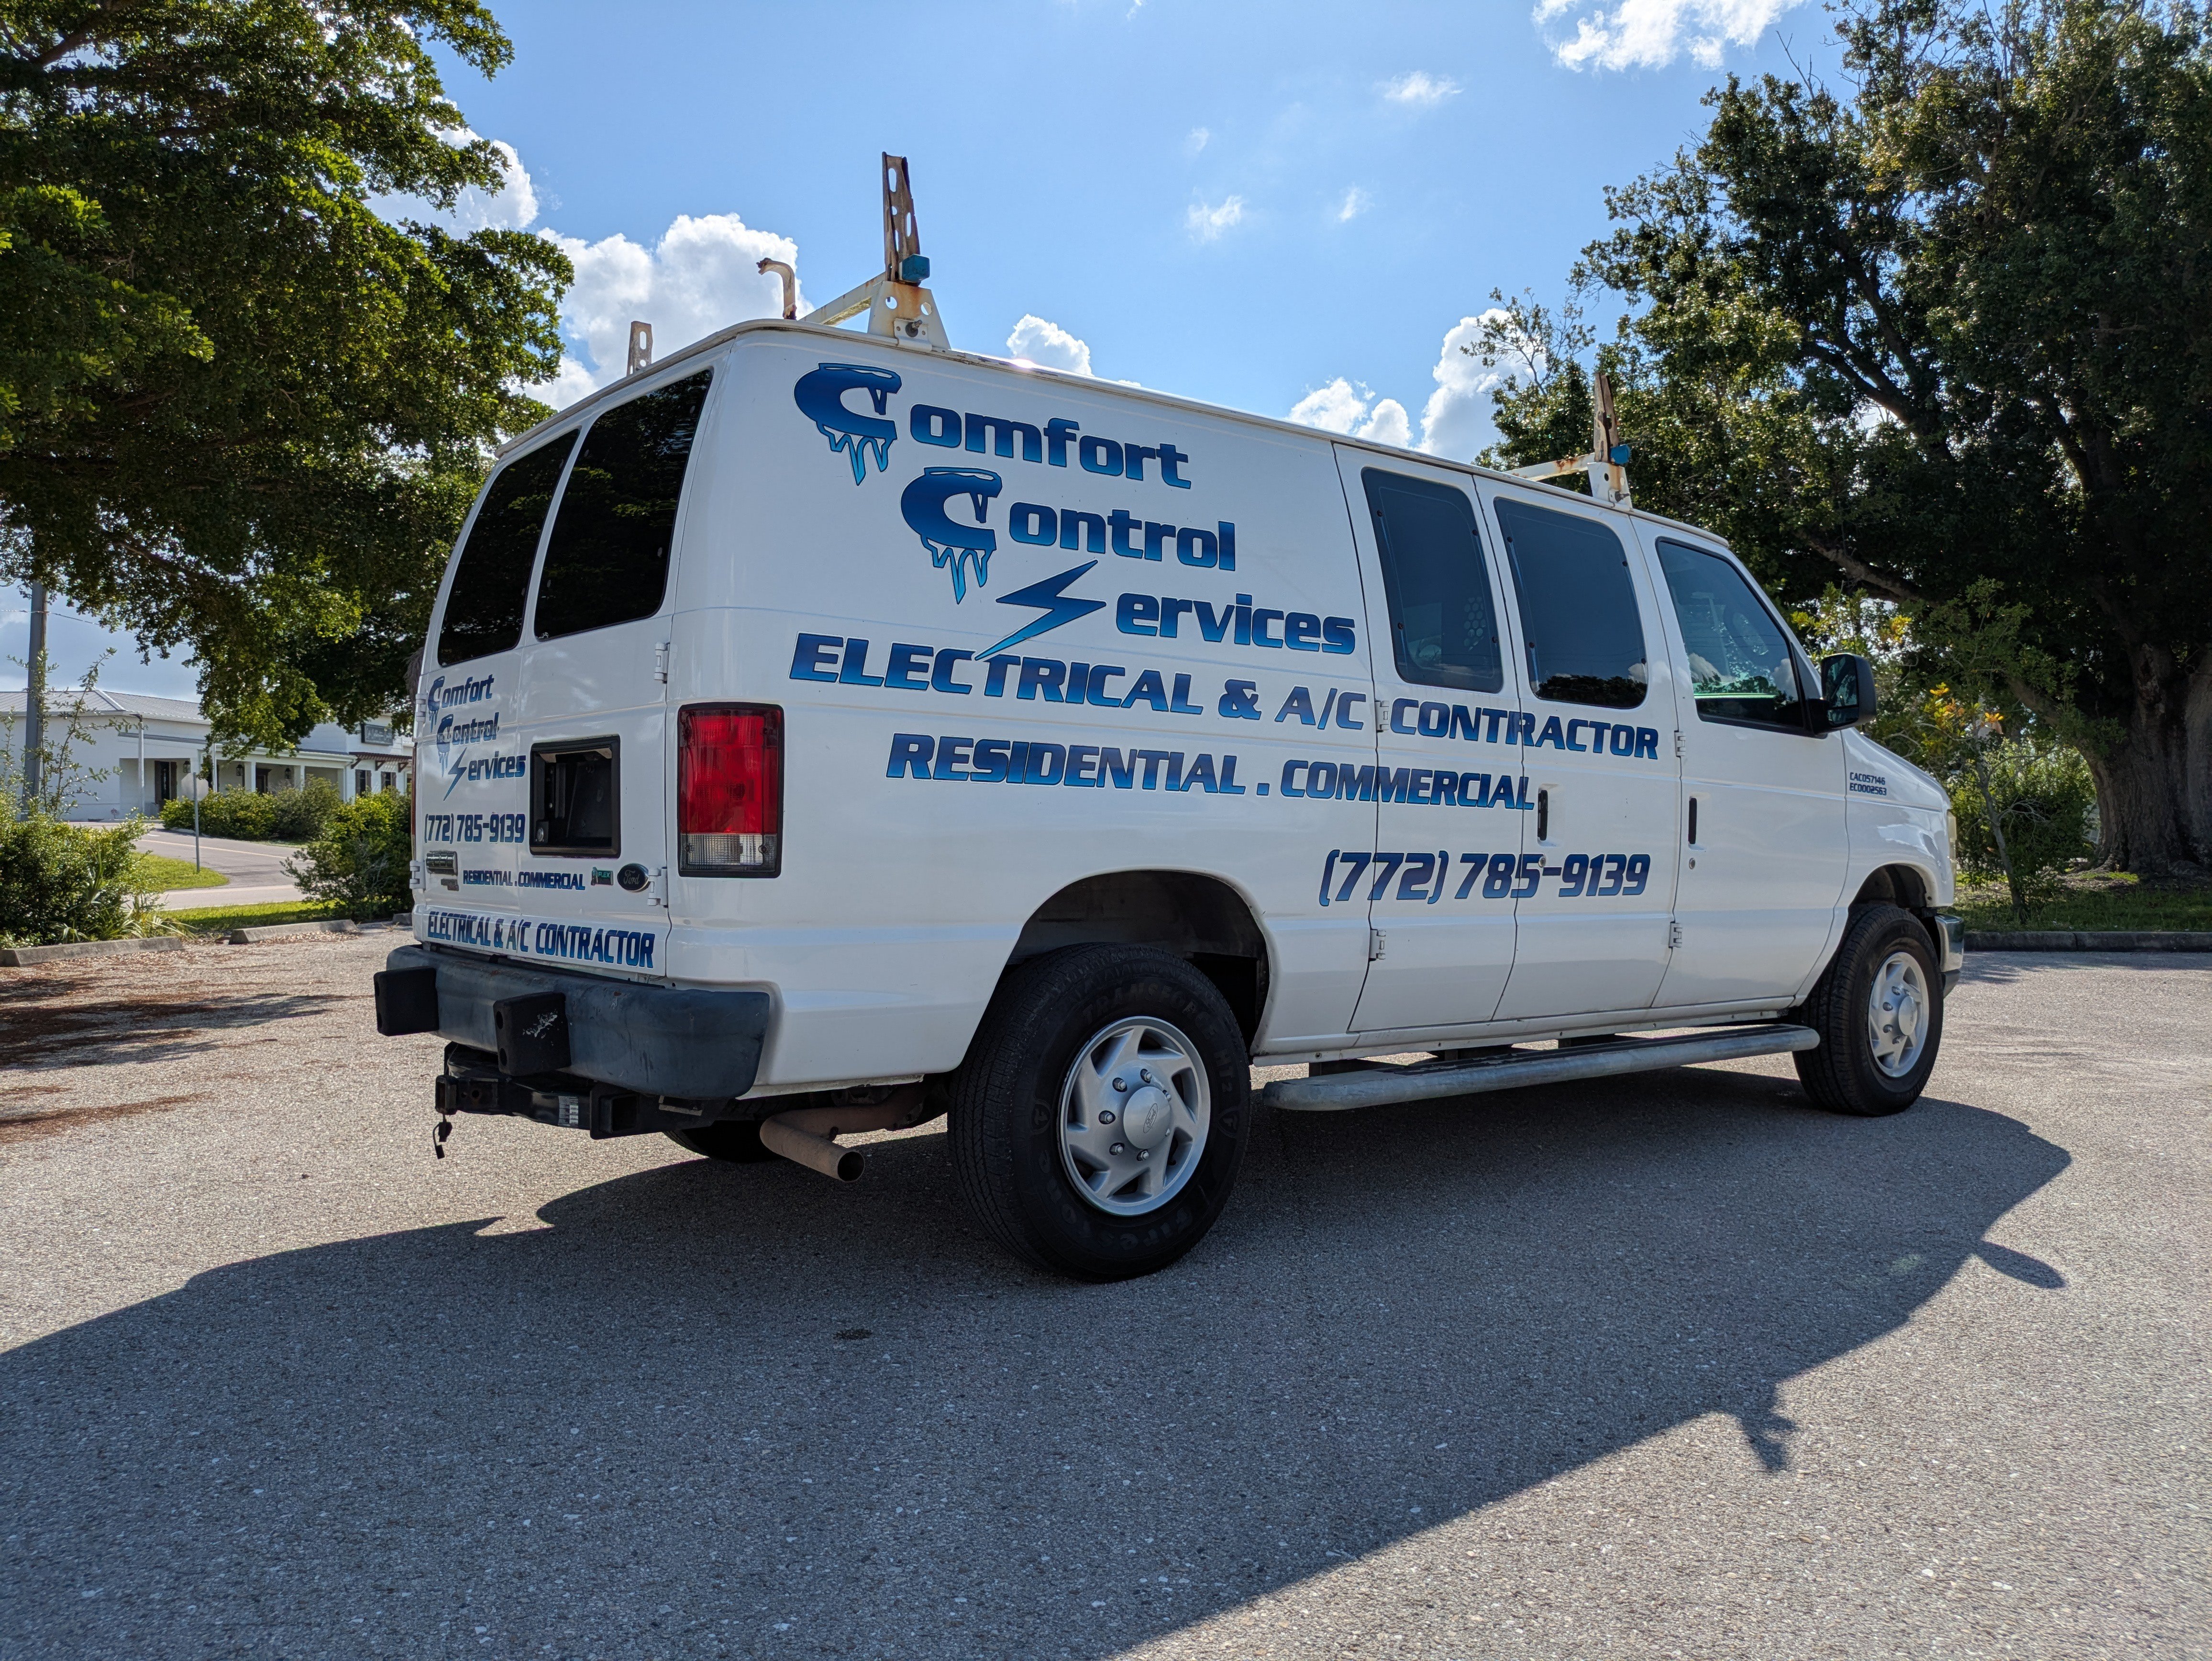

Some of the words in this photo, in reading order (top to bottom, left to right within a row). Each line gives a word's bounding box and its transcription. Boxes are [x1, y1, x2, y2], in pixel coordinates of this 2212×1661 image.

[794, 362, 1191, 489] Comfort
[901, 466, 1235, 605] Control
[428, 674, 495, 733] Comfort
[789, 633, 1203, 715] ELECTRICAL
[1218, 679, 1262, 720] &
[1274, 687, 1366, 730] A/C
[1390, 698, 1659, 760] CONTRACTOR
[437, 712, 499, 777] Control
[886, 733, 1246, 795] RESIDENTIAL
[1281, 760, 1535, 811] COMMERCIAL
[425, 813, 454, 844] (772)
[457, 814, 525, 843] 785-9139
[463, 870, 513, 886] RESIDENTIAL
[518, 872, 586, 890] COMMERCIAL
[623, 870, 640, 885] Ford
[1319, 850, 1449, 907] (772)
[1455, 853, 1651, 899] 785-9139
[428, 911, 491, 947] ELECTRICAL
[494, 919, 505, 949] &
[506, 919, 532, 953] A/C
[536, 923, 655, 969] CONTRACTOR
